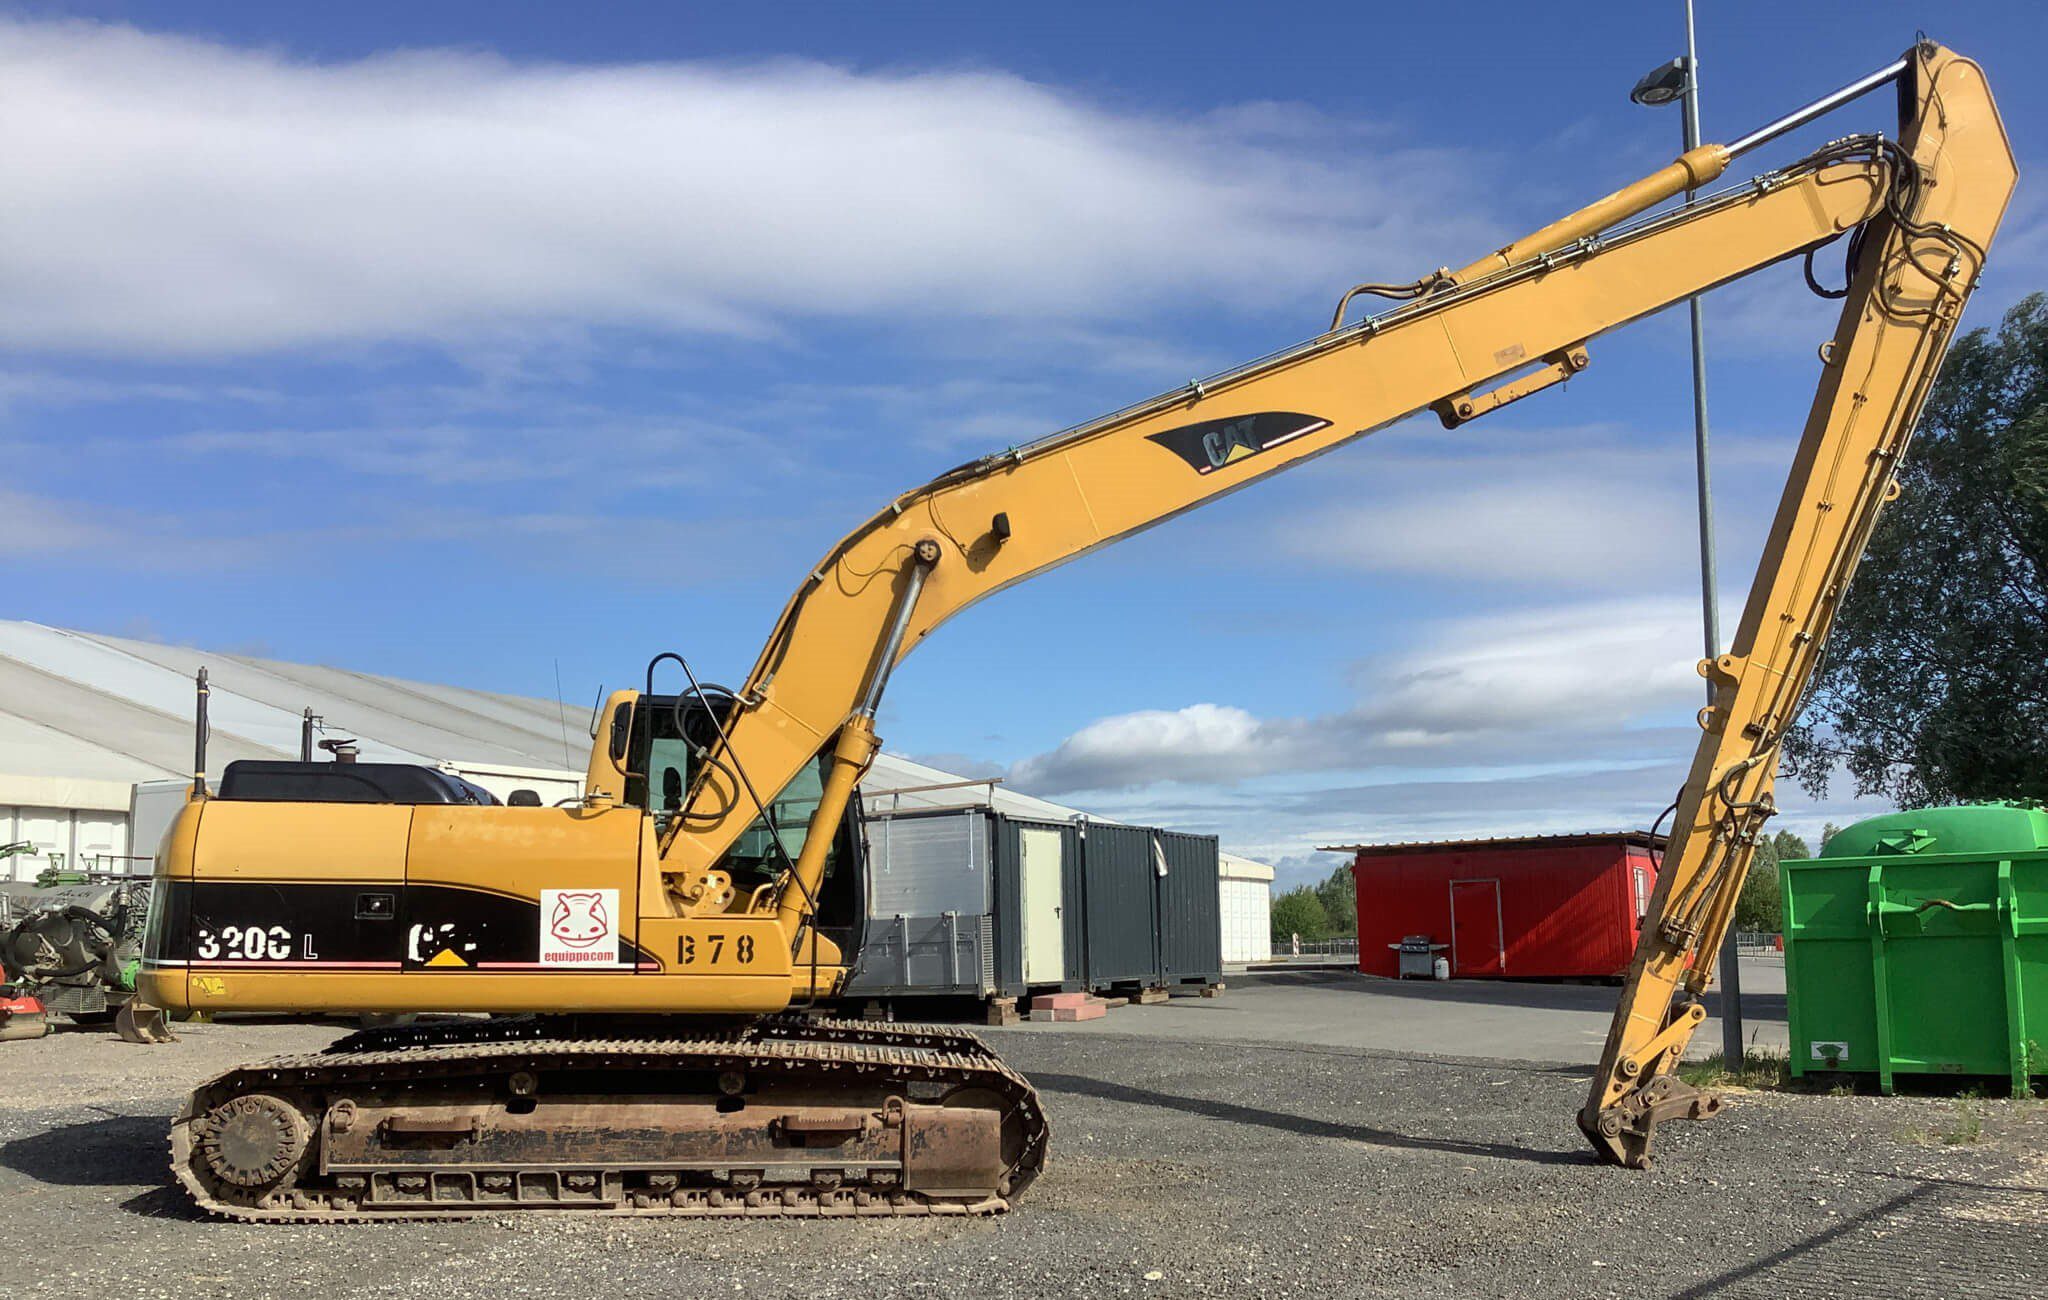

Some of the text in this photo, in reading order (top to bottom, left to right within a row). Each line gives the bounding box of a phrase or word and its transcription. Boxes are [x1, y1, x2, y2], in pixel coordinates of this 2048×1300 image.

[1202, 416, 1261, 467] CAT
[198, 925, 318, 959] 320C L
[544, 950, 614, 962] equippo.com
